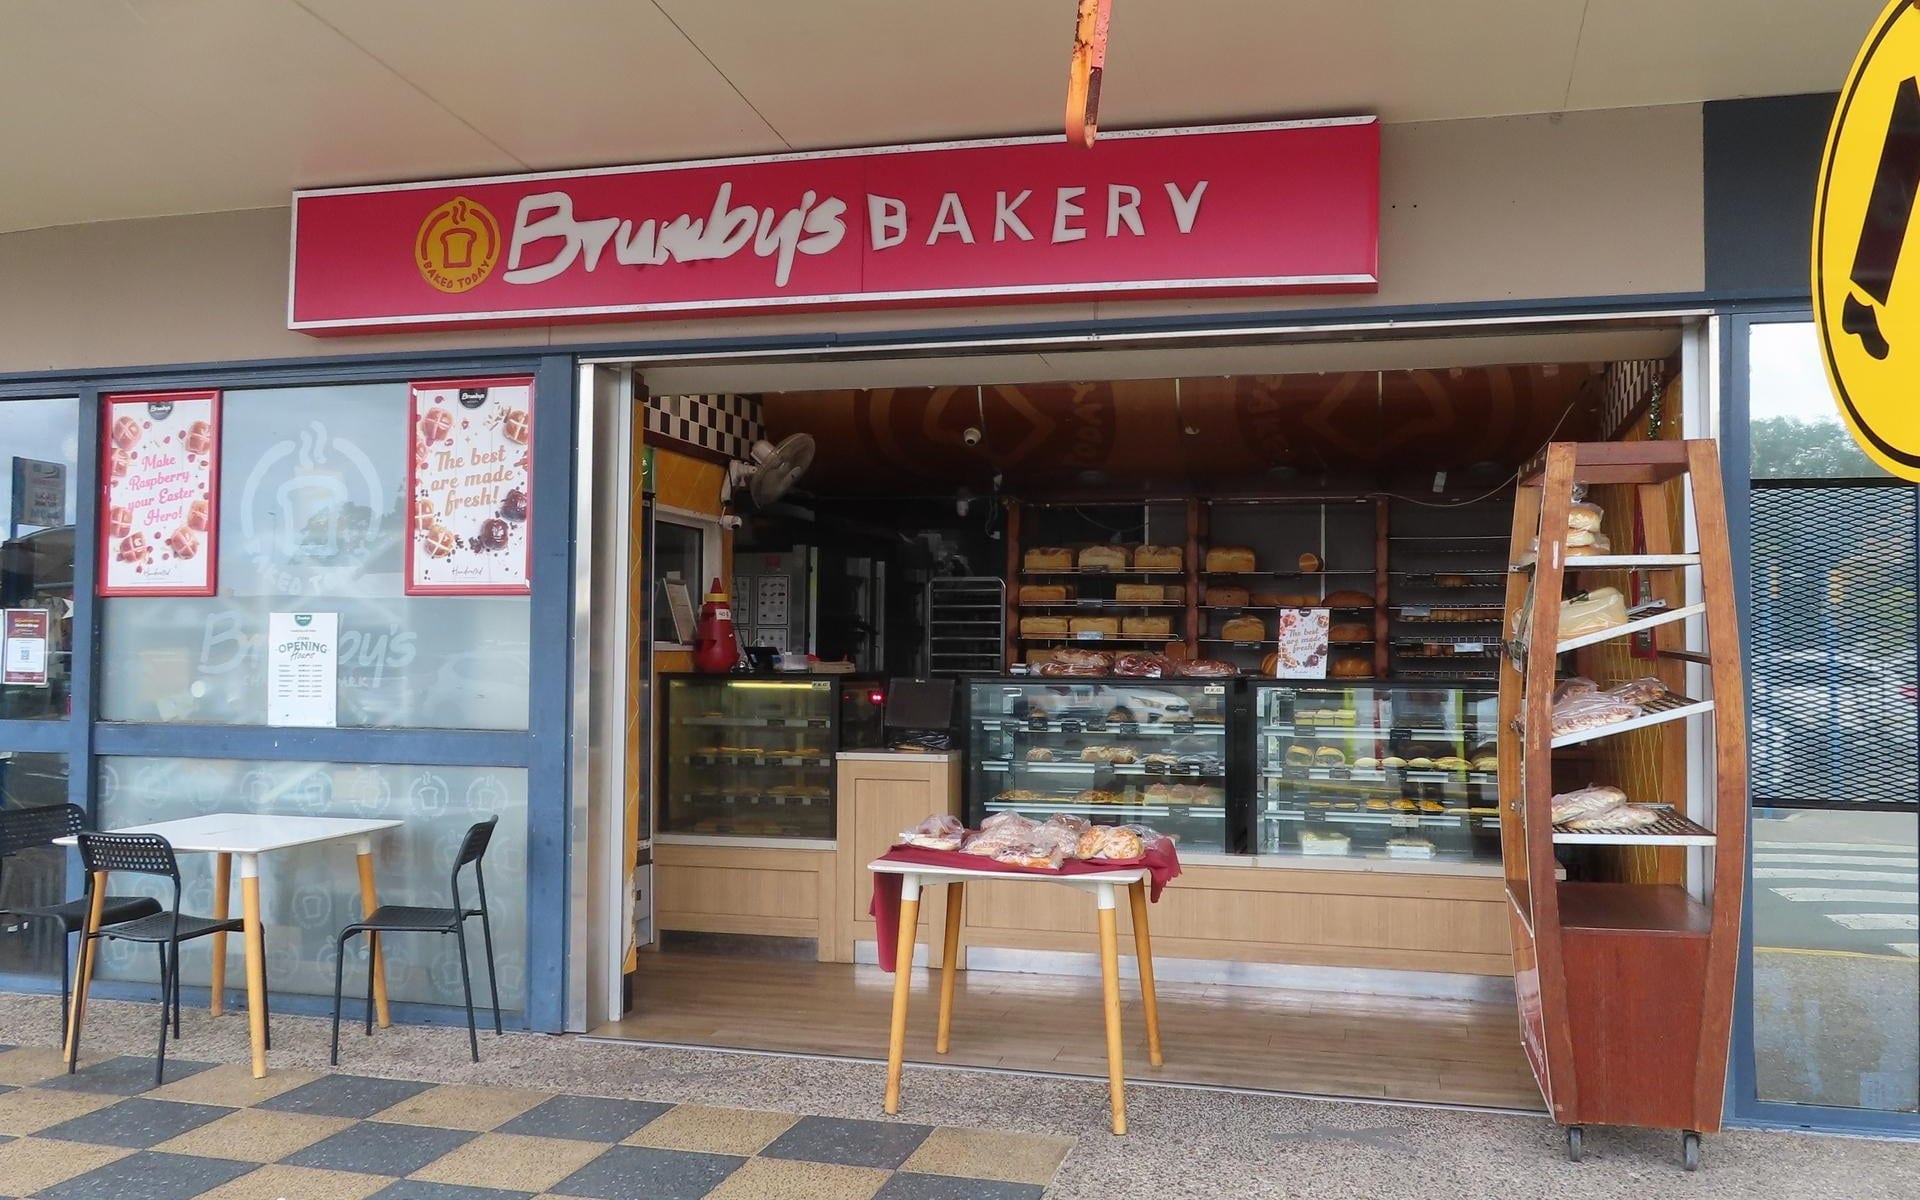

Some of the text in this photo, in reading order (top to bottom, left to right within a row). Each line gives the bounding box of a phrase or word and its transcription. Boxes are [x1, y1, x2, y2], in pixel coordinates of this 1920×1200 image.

[503, 182, 847, 287] Brumby's
[424, 260, 489, 288] BAKED TODAY
[142, 454, 176, 471] Make
[435, 445, 506, 472] The best
[129, 472, 189, 490] Raspberry
[431, 465, 514, 491] are made
[128, 488, 194, 512] your Easter
[445, 486, 499, 517] fresh!
[144, 506, 182, 526] Hero!
[198, 610, 417, 688] Brby's
[278, 641, 327, 653] OPENING
